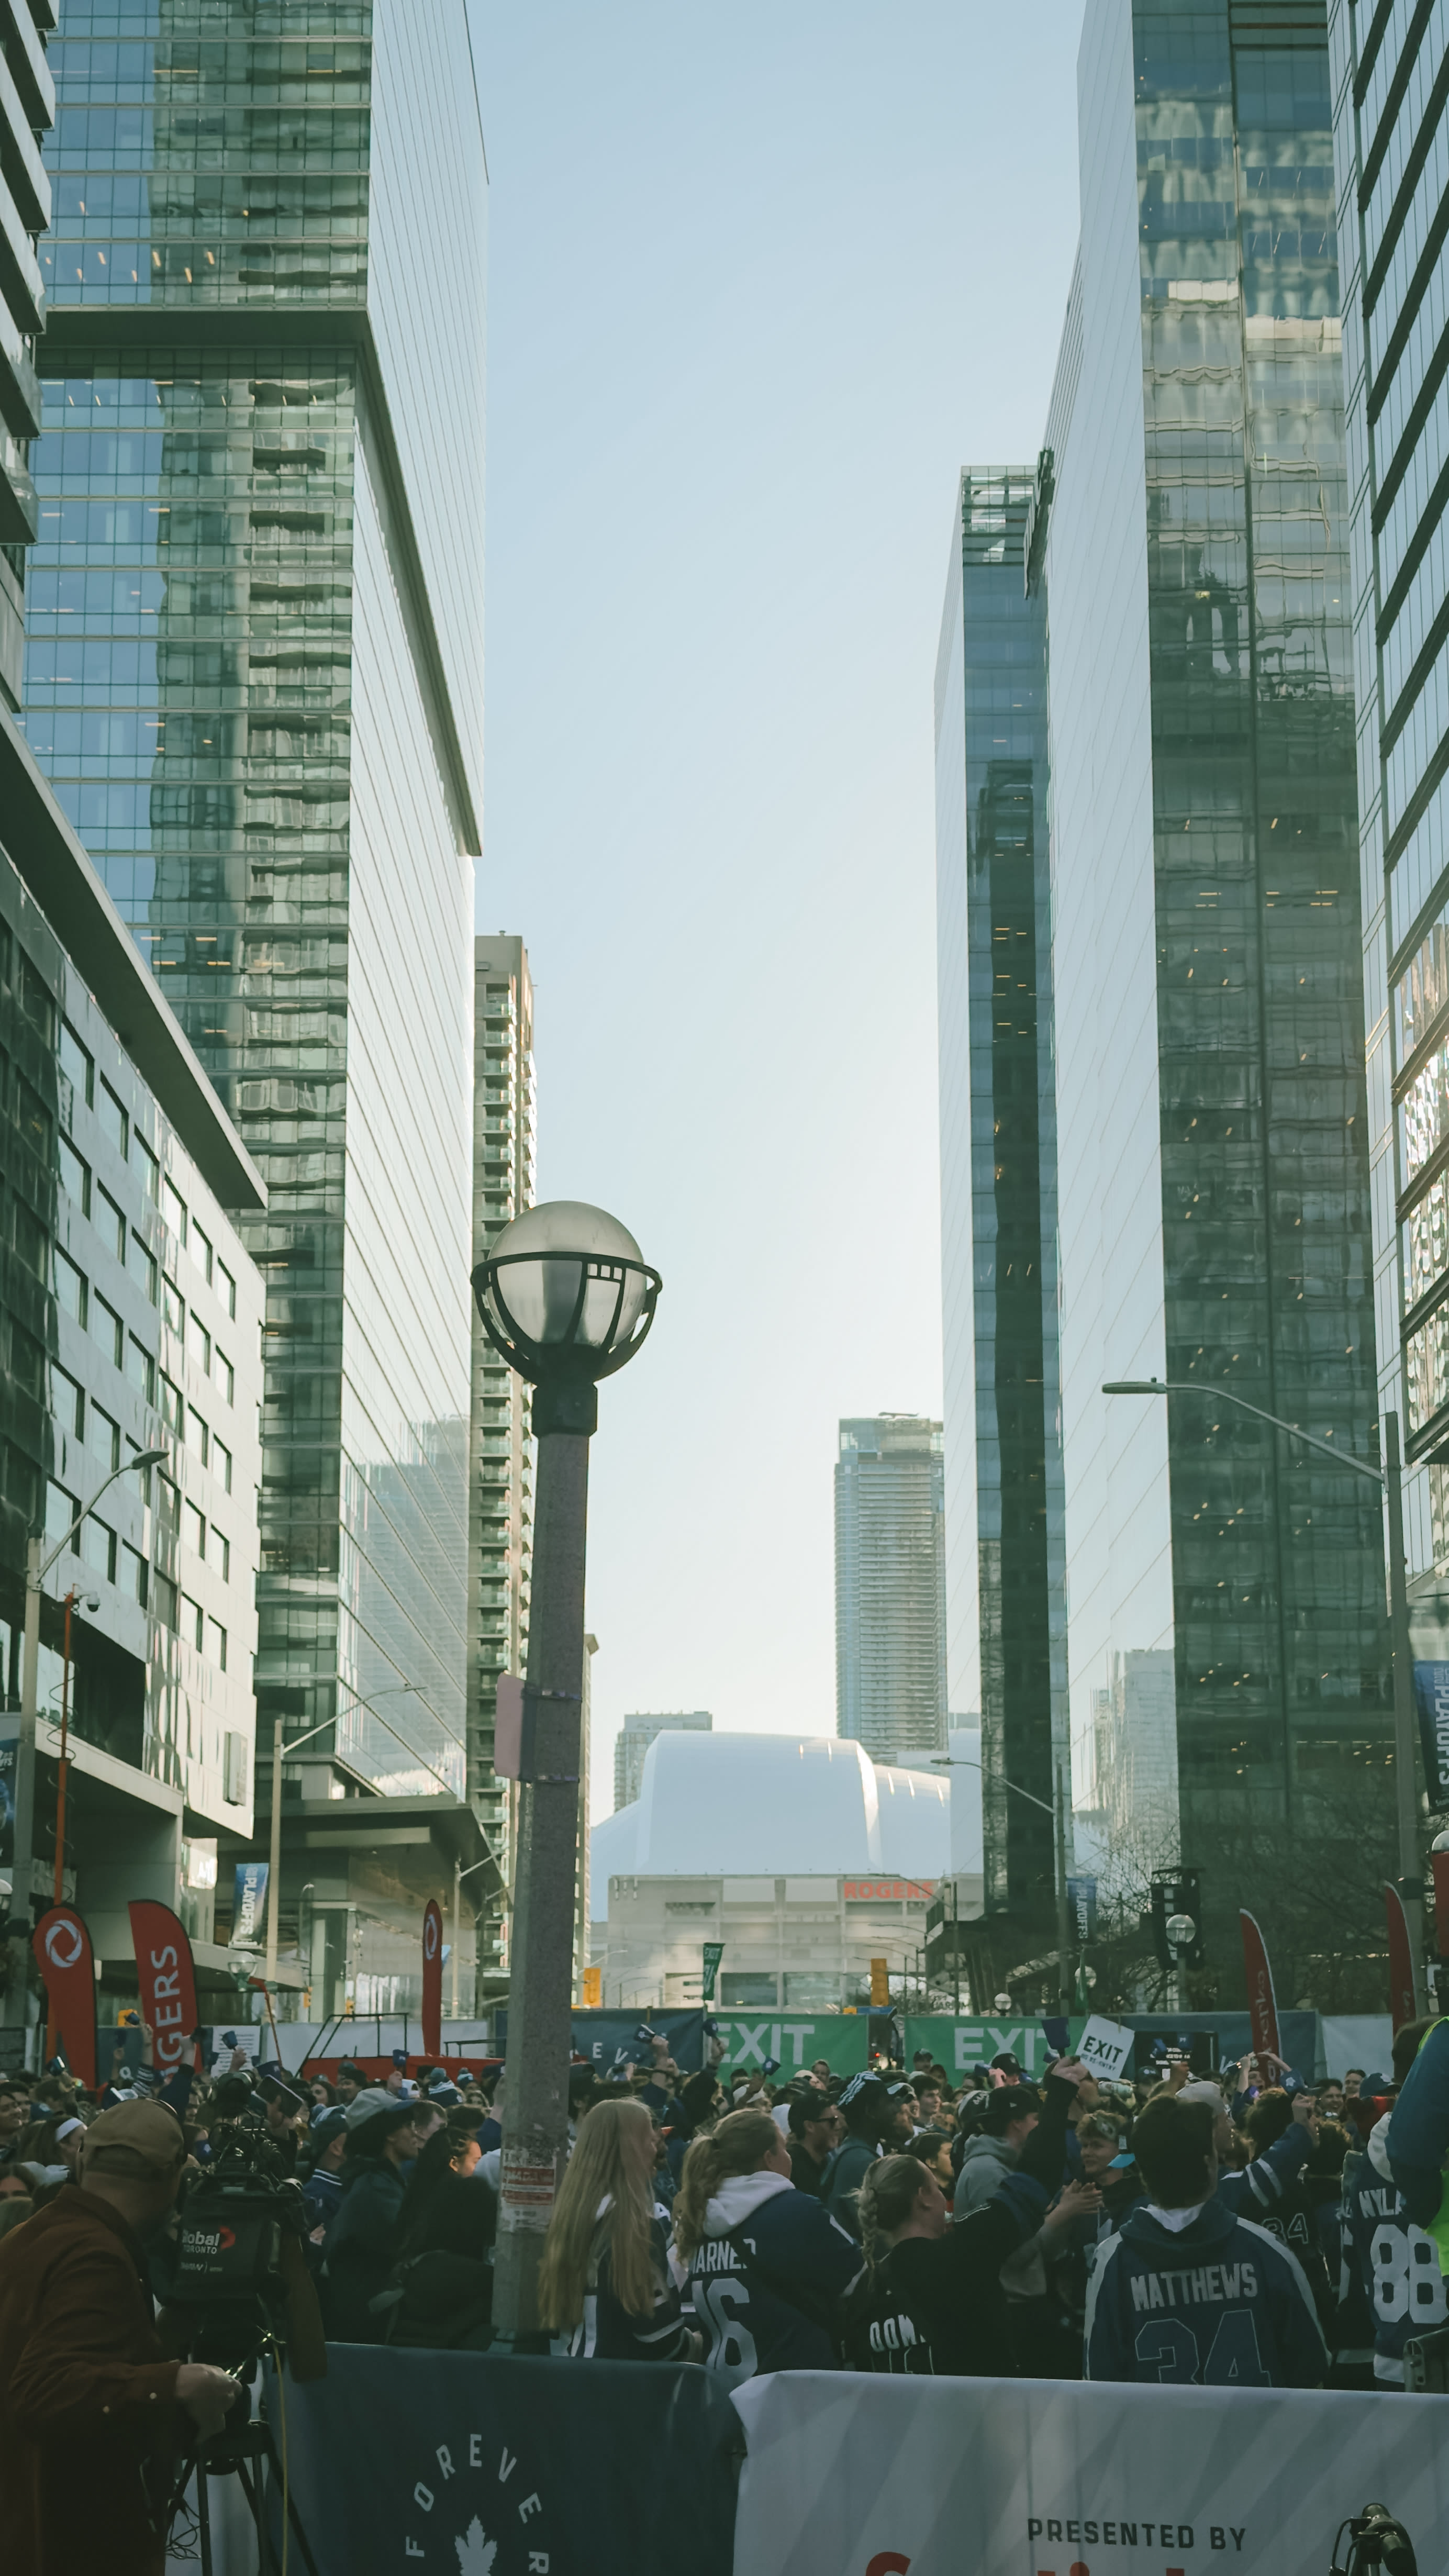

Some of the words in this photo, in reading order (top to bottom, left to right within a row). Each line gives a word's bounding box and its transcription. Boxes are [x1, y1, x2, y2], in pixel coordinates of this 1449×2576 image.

[240, 1877, 257, 1935] PLAYOFFS
[843, 1881, 934, 1899] ROGERS
[1083, 2036, 1123, 2064] EXIT
[1130, 2263, 1258, 2312] MATTHEWS
[1370, 2224, 1449, 2324] 88
[691, 2278, 759, 2385] 16
[1134, 2309, 1273, 2388] 34
[405, 2433, 549, 2574] FOREVER
[1027, 2518, 1194, 2549] PRESENTED
[1210, 2527, 1246, 2551] BY
